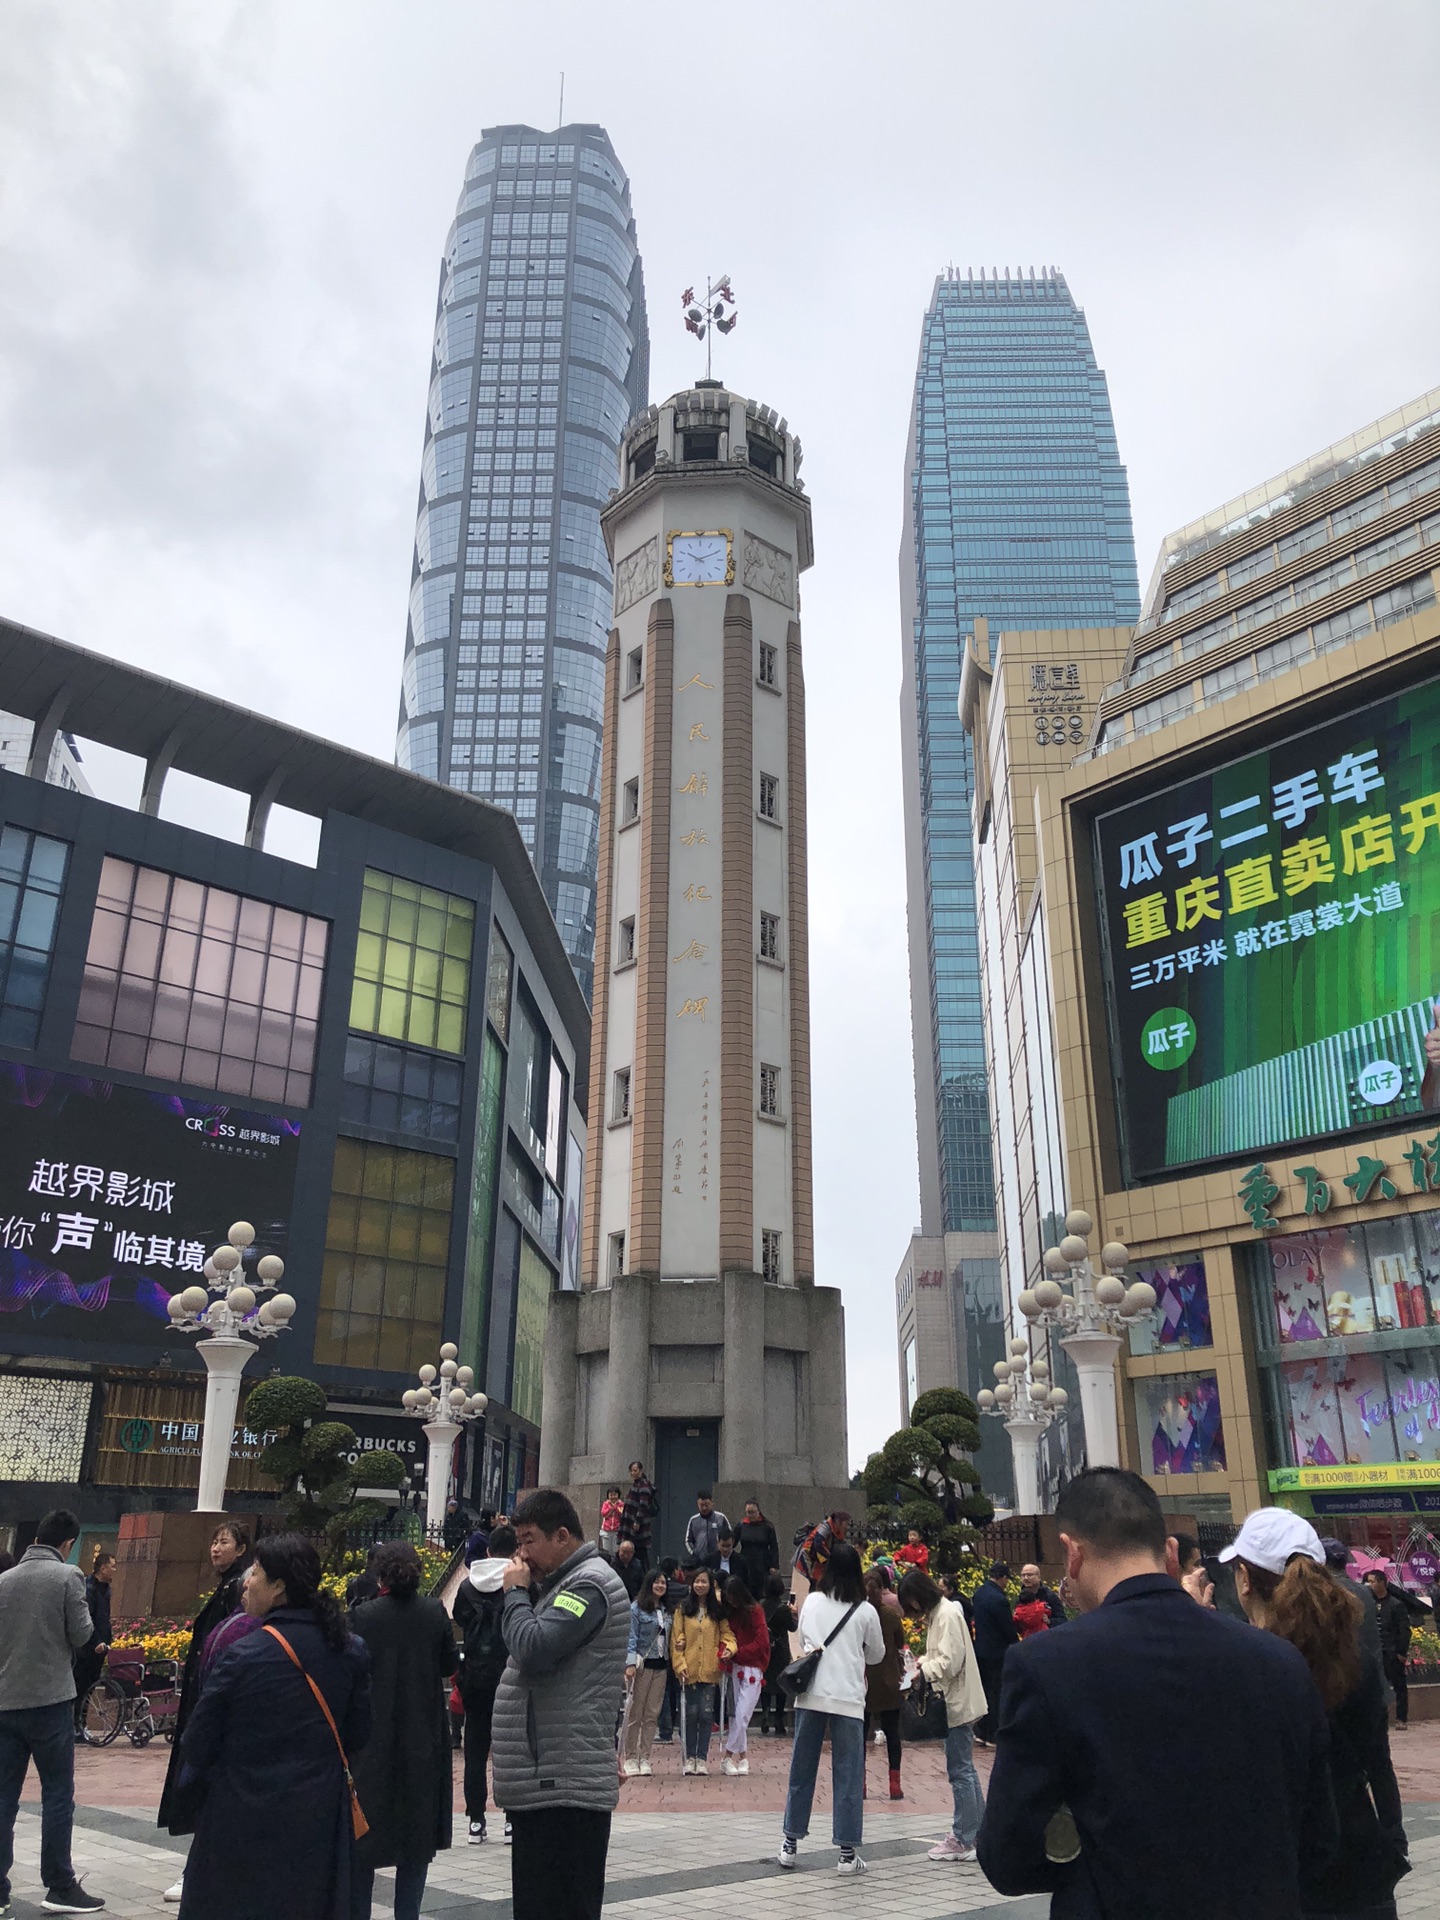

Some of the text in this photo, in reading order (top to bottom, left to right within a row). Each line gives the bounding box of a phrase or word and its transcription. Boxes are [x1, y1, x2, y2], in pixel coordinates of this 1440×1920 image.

[1119, 749, 1386, 889] 瓜子二手车
[1123, 792, 1440, 949] 重庆直卖店开
[1130, 880, 1404, 990] 三万平米 就在霓裳大道
[1147, 1021, 1190, 1055] 瓜子
[1364, 1070, 1398, 1094] 瓜子
[185, 1116, 281, 1146] CROSS 越界影城
[28, 1158, 176, 1214] 越界影城
[1272, 1245, 1325, 1269] OLAY
[161, 1421, 278, 1446] 中国银行
[352, 1436, 416, 1453] RBUCKS
[558, 1597, 580, 1611] italia
